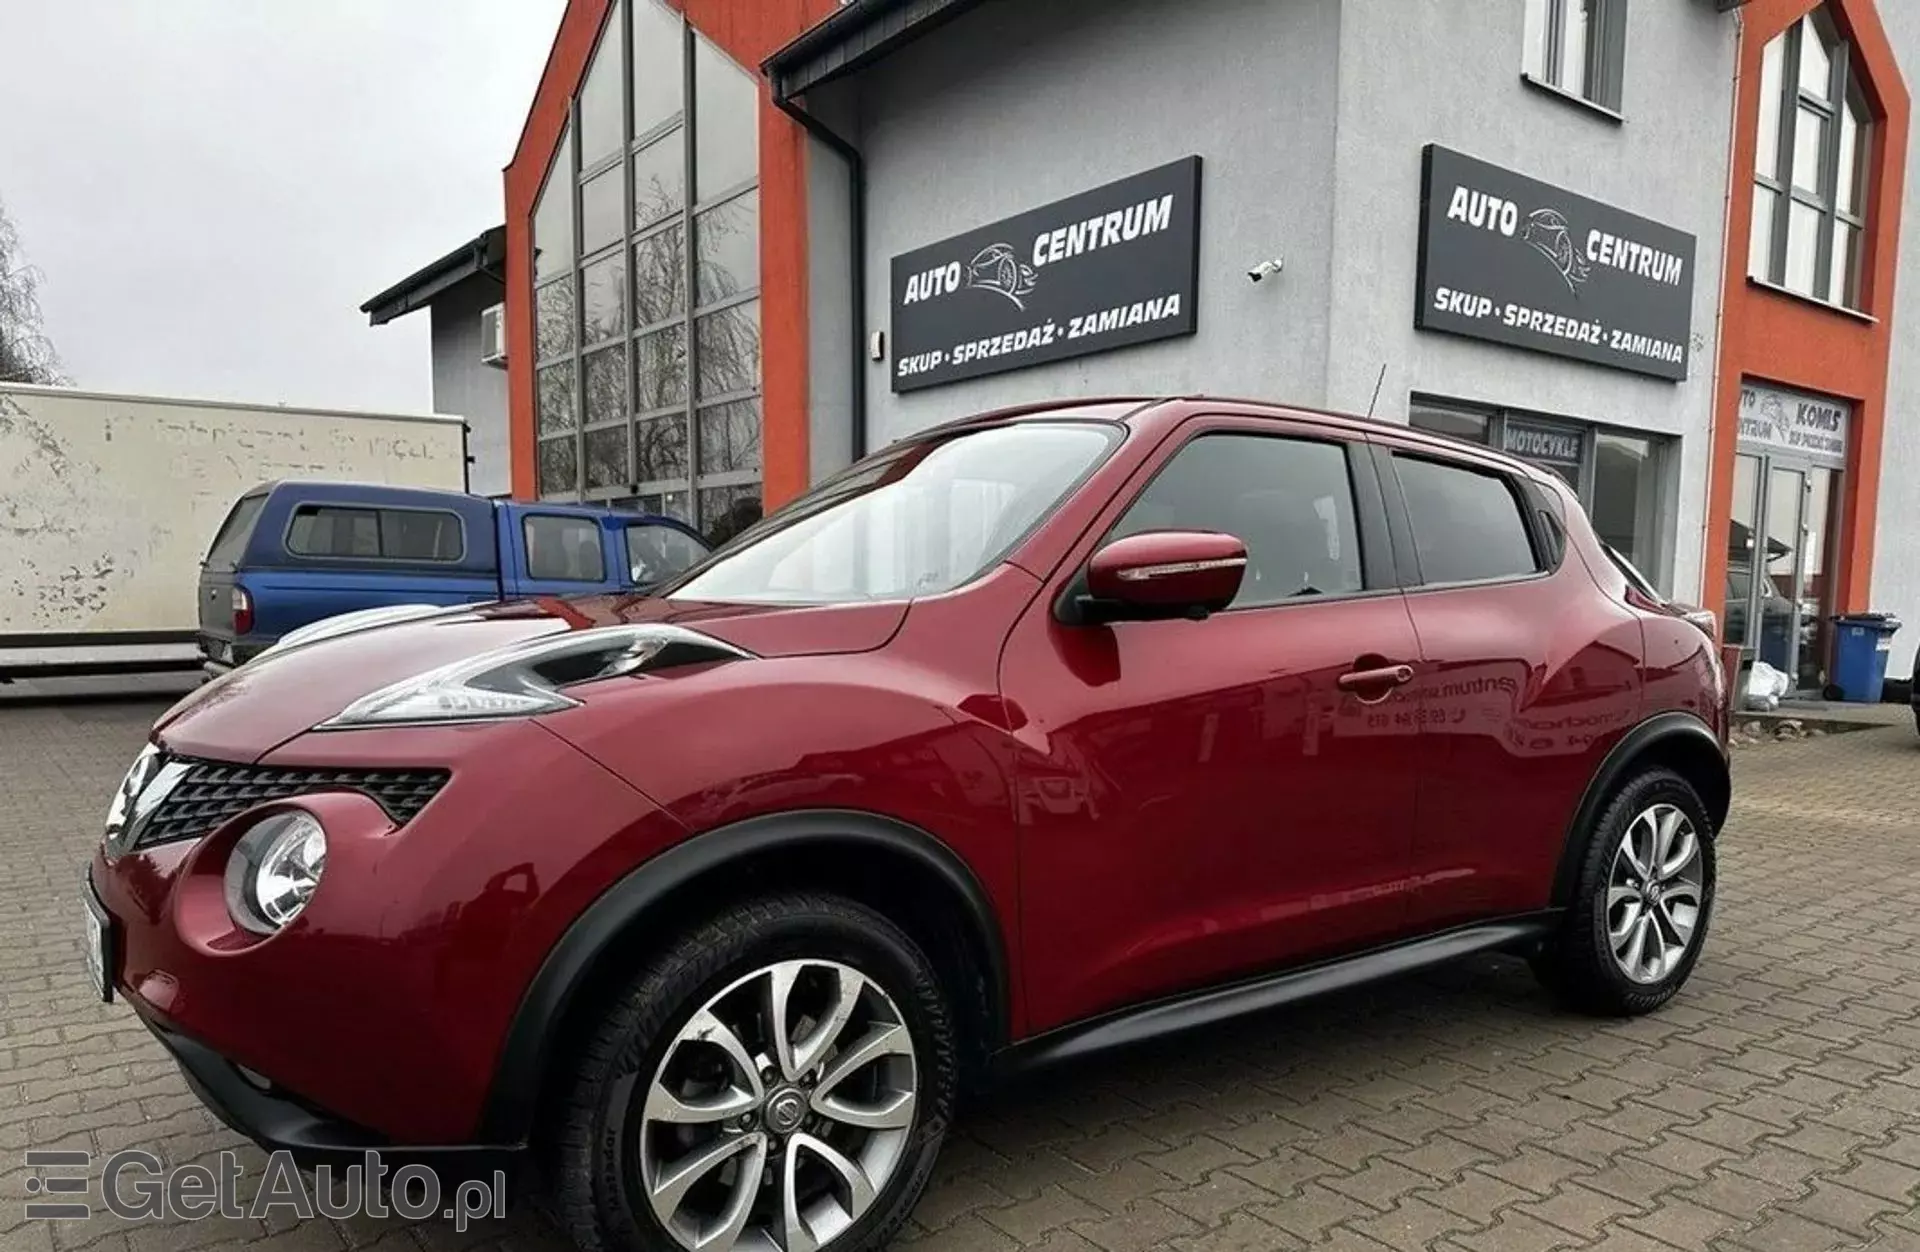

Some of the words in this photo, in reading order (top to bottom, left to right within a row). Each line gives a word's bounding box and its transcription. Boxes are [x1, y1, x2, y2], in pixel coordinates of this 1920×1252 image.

[903, 261, 961, 305] AUTO
[1032, 194, 1174, 268] CENTRUM
[1447, 185, 1518, 237] AUTO
[1587, 229, 1683, 286] CENTRUM
[897, 351, 942, 377] SKUP
[952, 318, 1056, 366] SPRZEDAŻ
[1067, 294, 1180, 340] ZAMIANA
[1434, 287, 1493, 319] SKUP
[1503, 304, 1602, 345] SPRZEDAŻ
[1610, 329, 1683, 364] ZAMIANA
[1506, 428, 1579, 458] MOTOCYKLE
[1795, 403, 1842, 433] KOMIS
